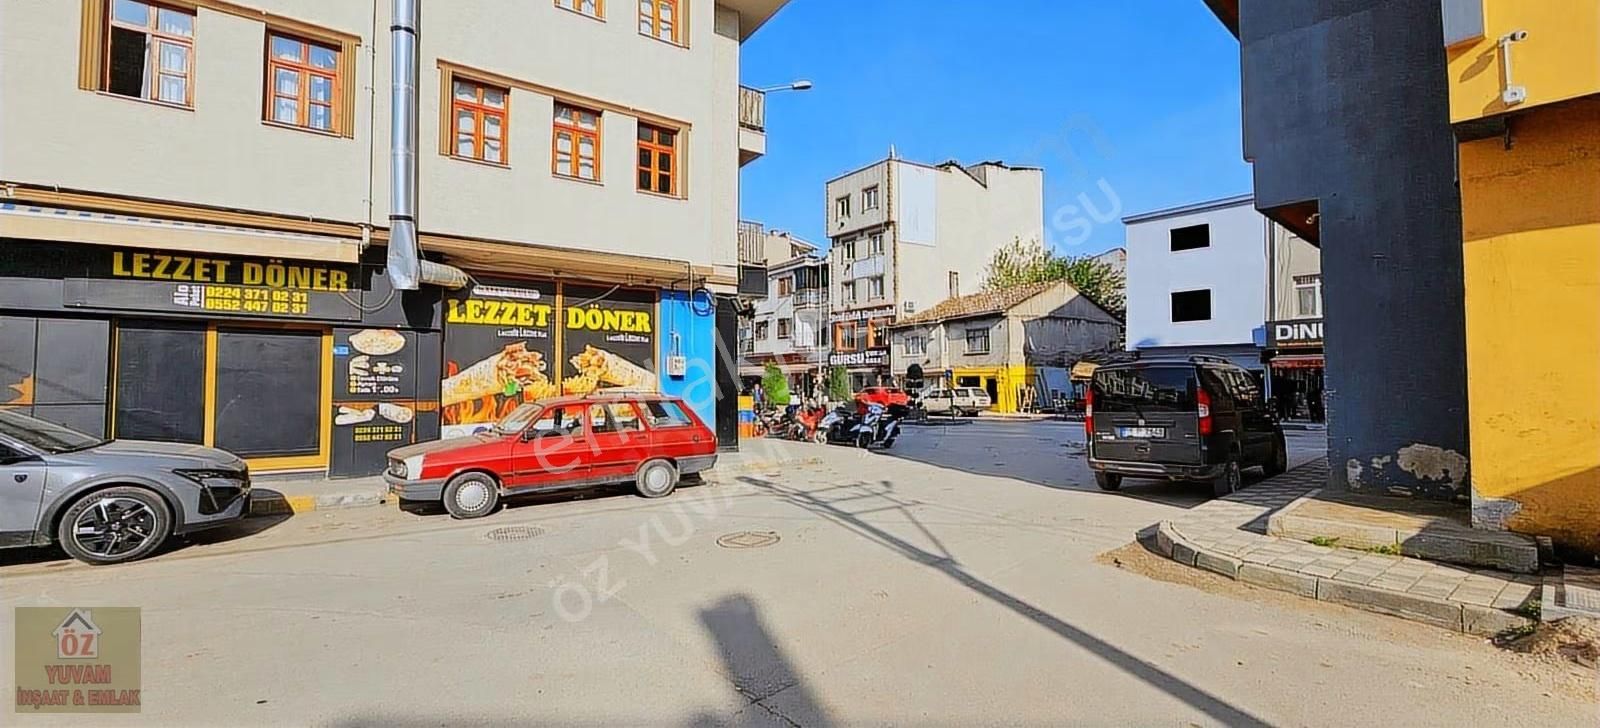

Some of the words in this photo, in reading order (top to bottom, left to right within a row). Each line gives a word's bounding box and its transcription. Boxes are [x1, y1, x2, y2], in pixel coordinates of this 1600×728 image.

[113, 251, 231, 283] LEZZET
[243, 259, 348, 292] DÖNER
[173, 284, 189, 306] Alo
[205, 285, 241, 299] 0224
[243, 288, 269, 301] 371
[272, 290, 289, 302] 02
[291, 291, 308, 303] 31
[205, 297, 241, 311] 0552
[243, 300, 269, 312] 447
[272, 302, 289, 314] 02
[291, 302, 308, 314] 31
[447, 298, 551, 327] LEZZET
[566, 303, 652, 333] DÖNER
[830, 351, 865, 365] GÜRSU
